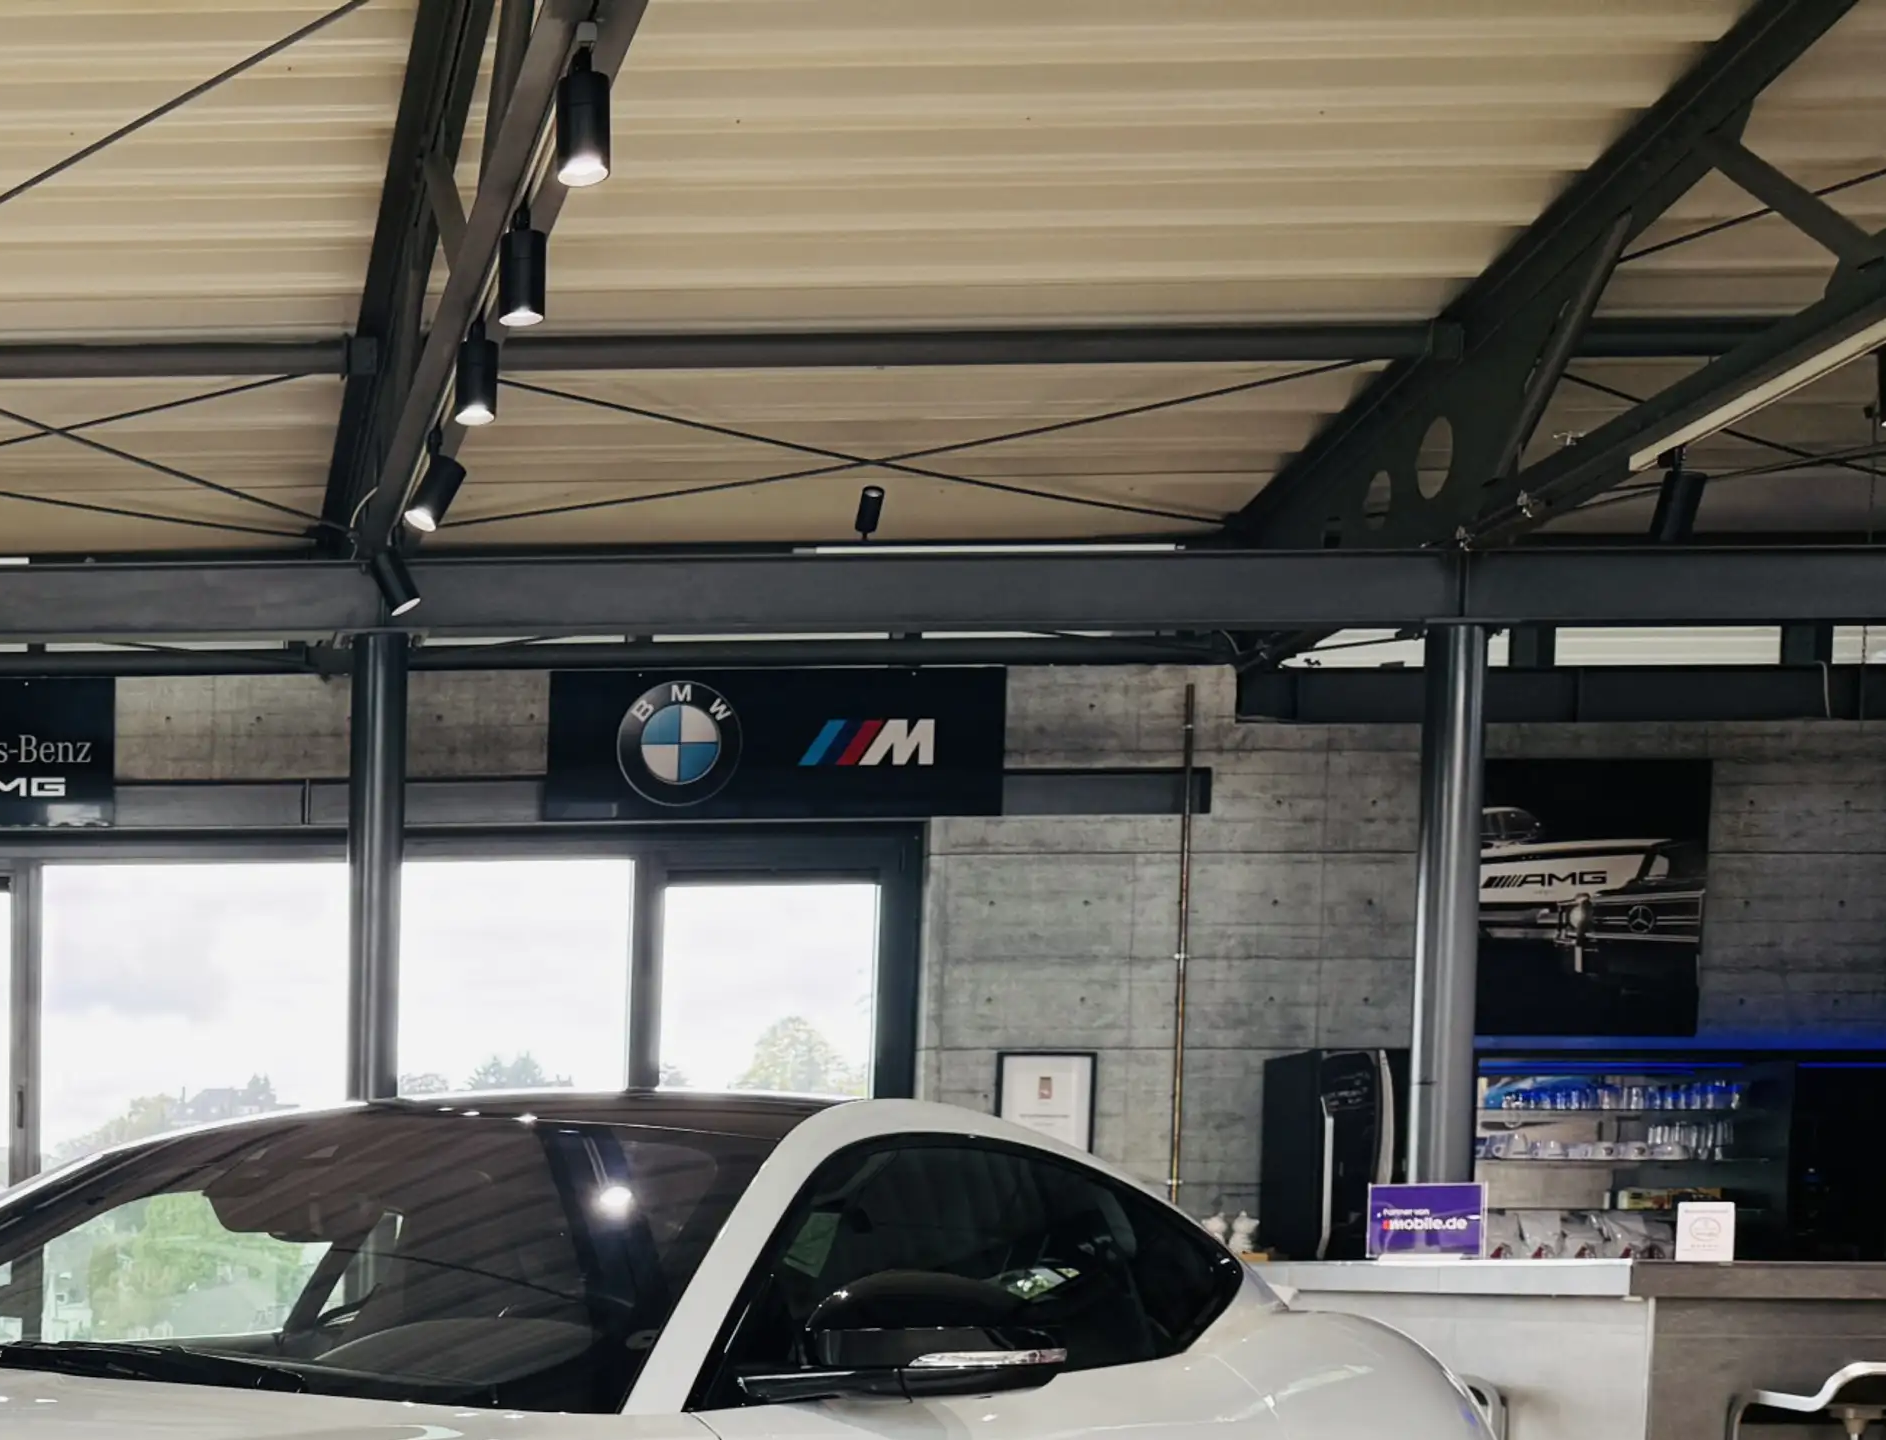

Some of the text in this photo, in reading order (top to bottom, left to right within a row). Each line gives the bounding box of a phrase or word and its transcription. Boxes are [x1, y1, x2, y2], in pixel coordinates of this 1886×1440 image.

[630, 683, 732, 722] BMW
[1518, 870, 1608, 888] AMG
[1389, 1217, 1468, 1231] mobile.de
